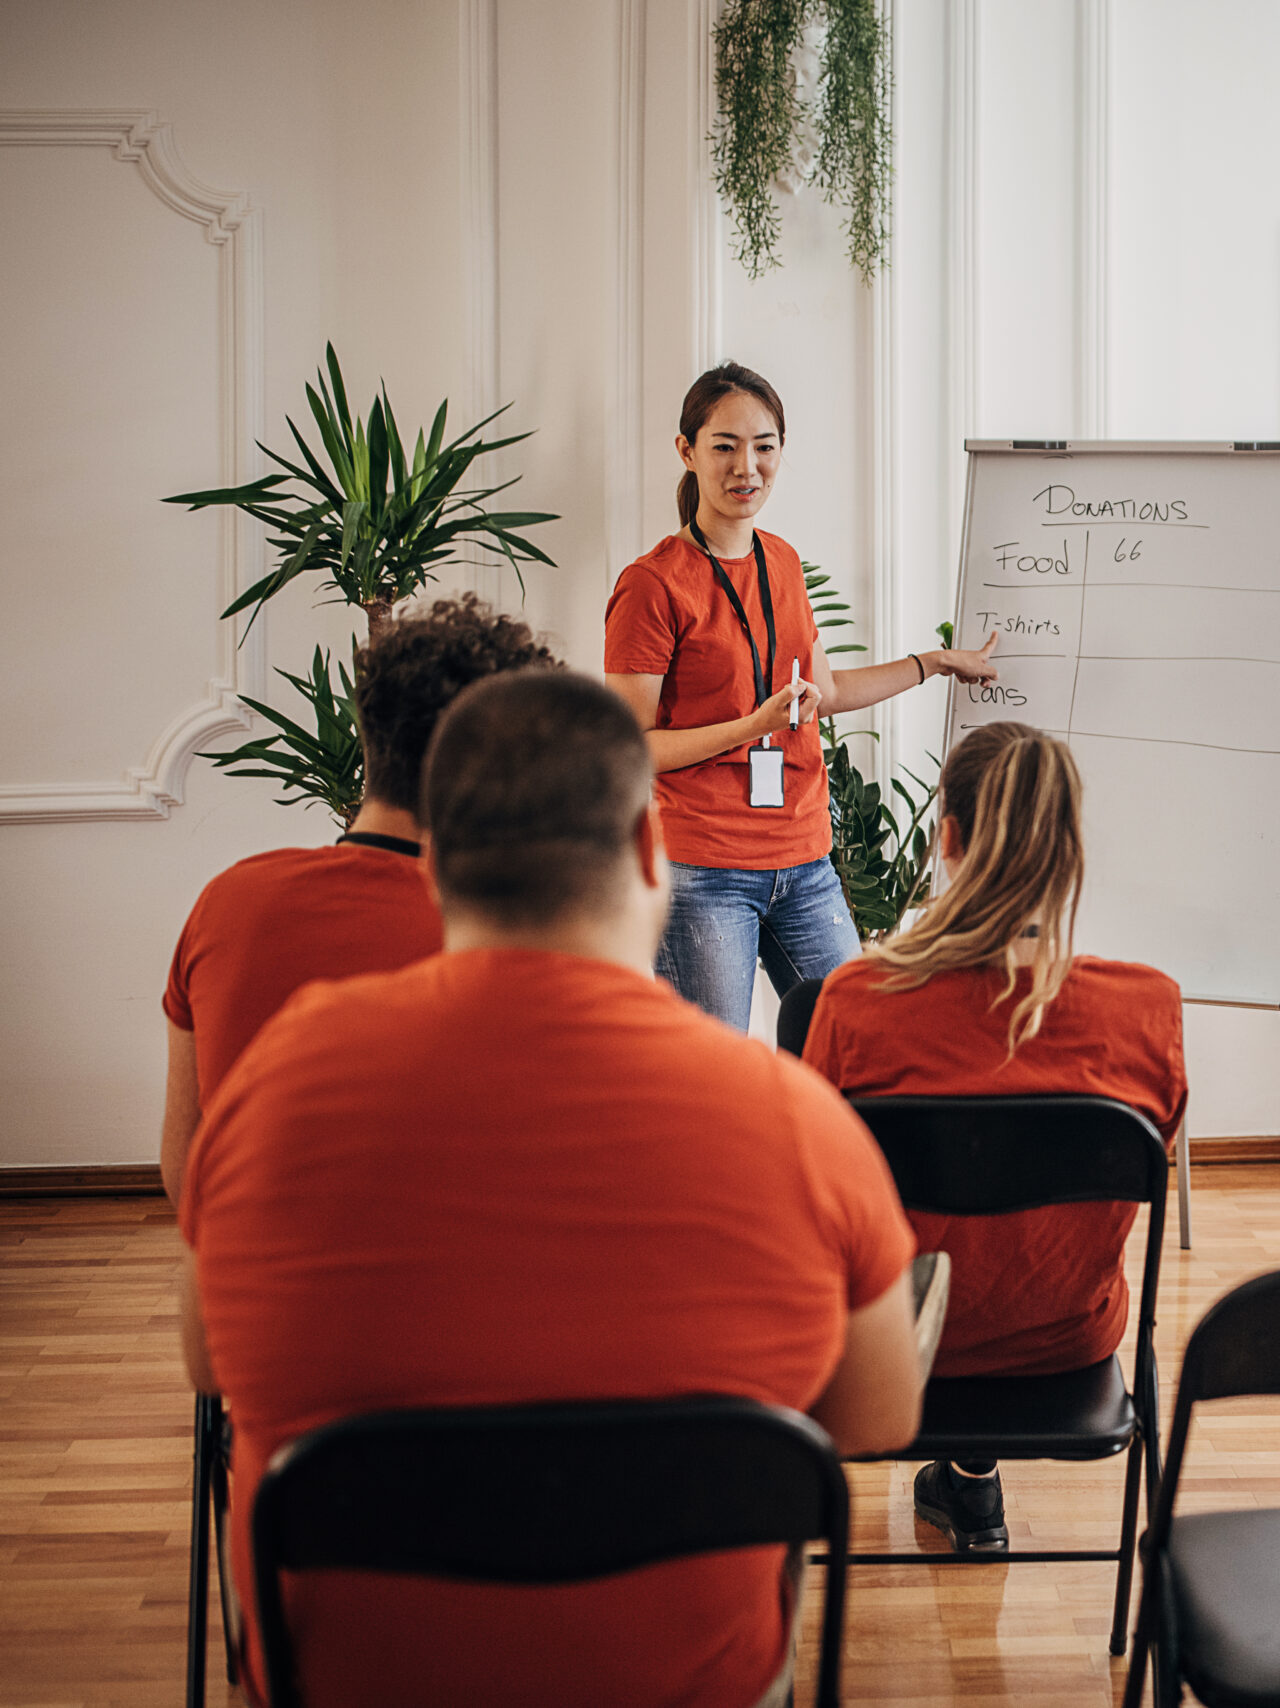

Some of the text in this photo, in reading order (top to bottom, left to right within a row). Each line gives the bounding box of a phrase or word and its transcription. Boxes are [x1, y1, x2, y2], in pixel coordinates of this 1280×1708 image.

[1033, 484, 1189, 522] DONATIONS
[993, 538, 1073, 575] Food
[1113, 537, 1143, 563] 66
[975, 611, 1061, 635] T-shirts
